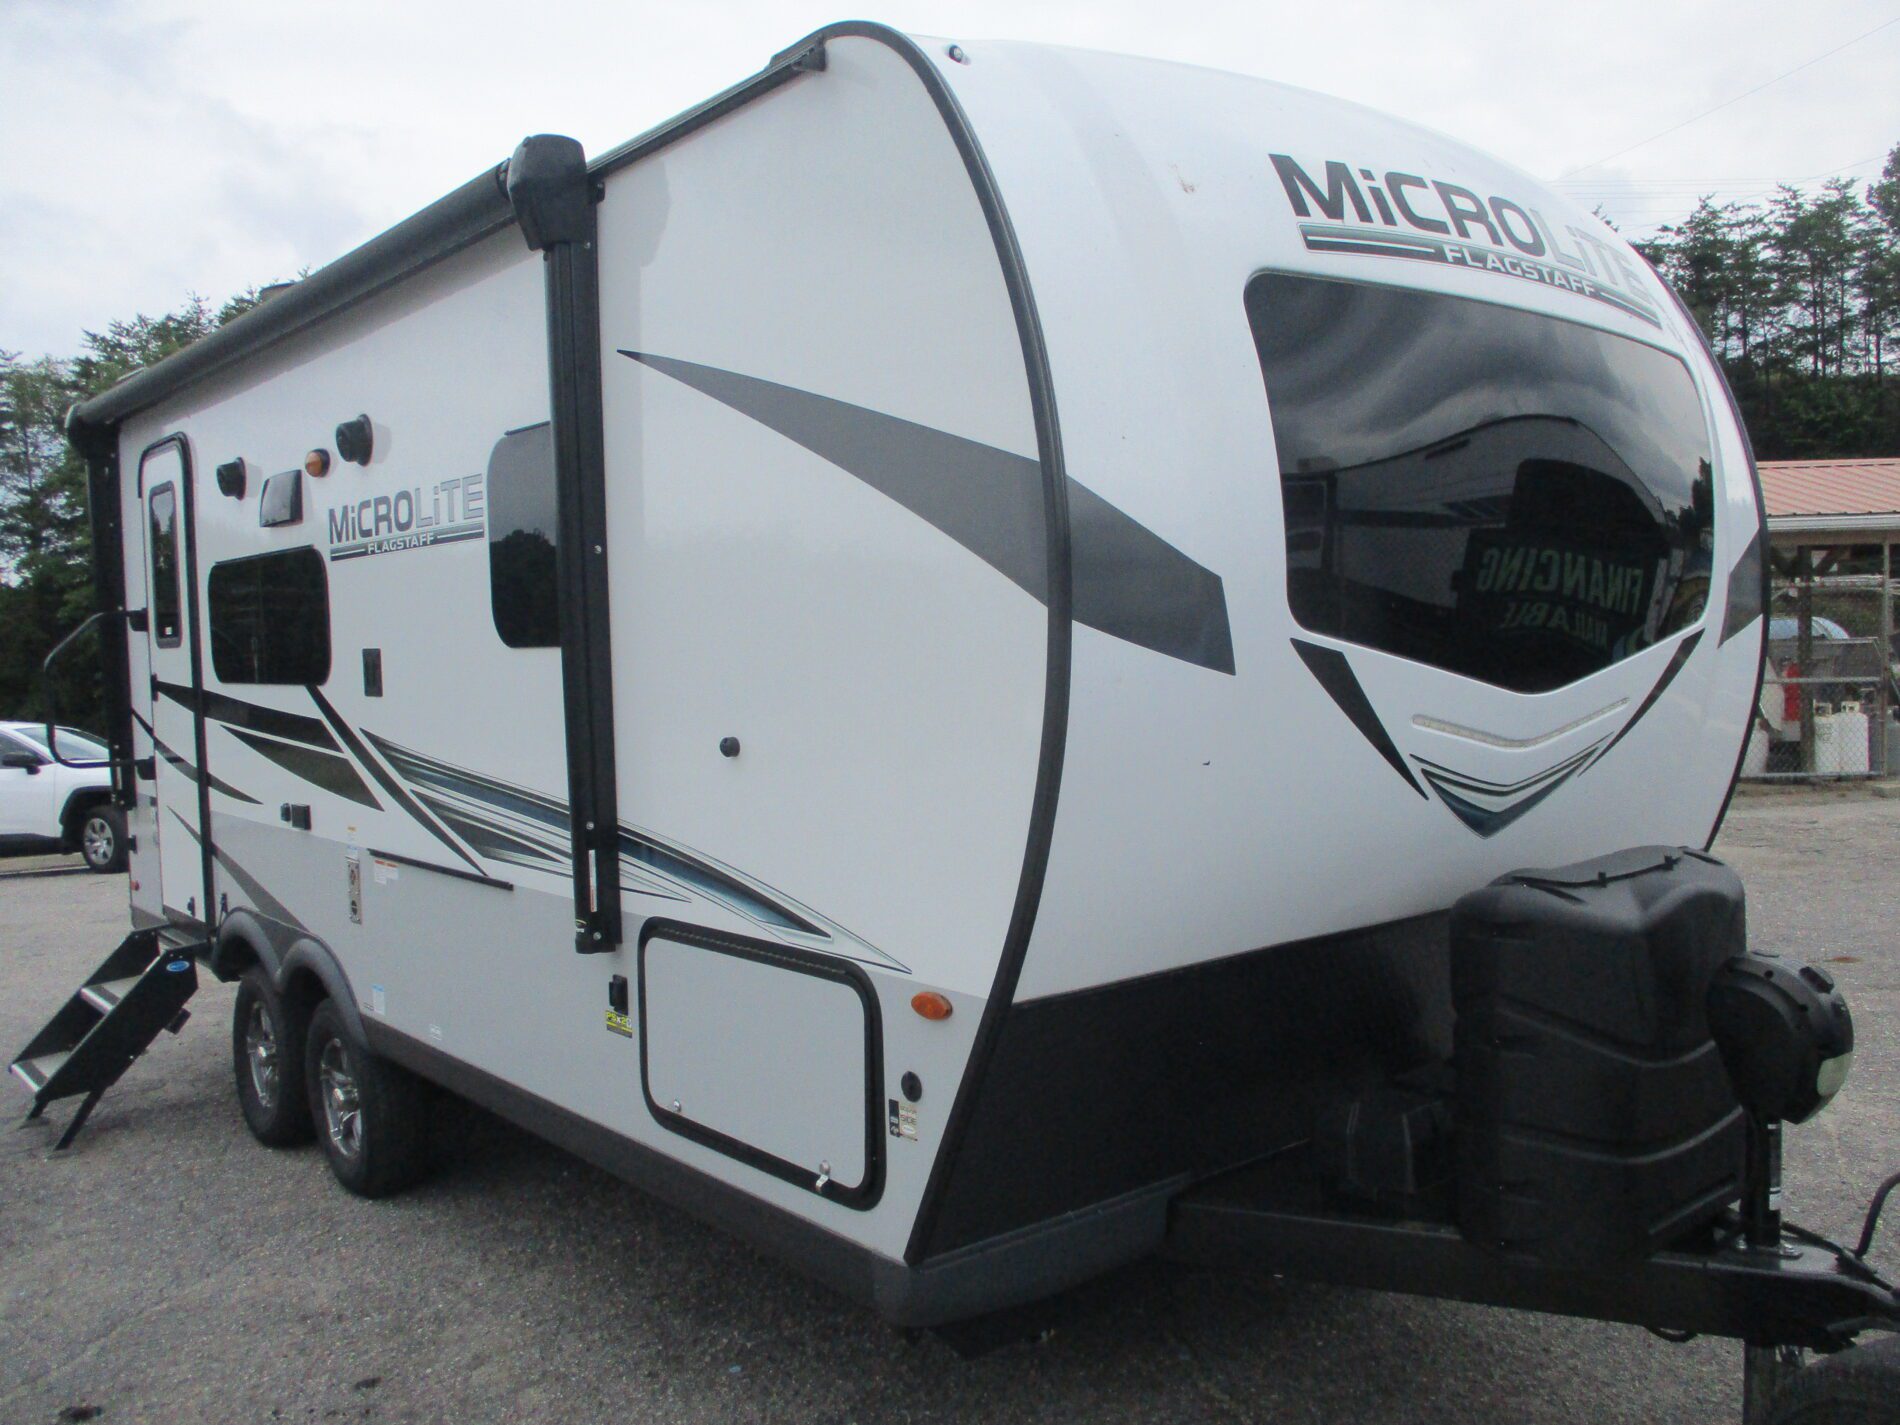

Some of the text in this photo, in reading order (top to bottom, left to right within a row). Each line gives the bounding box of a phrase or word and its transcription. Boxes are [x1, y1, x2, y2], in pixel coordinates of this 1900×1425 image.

[1442, 243, 1596, 297] FLAGSTAFF
[328, 473, 485, 545] MiCROLiTE
[368, 532, 435, 555] FLAGSTAFF
